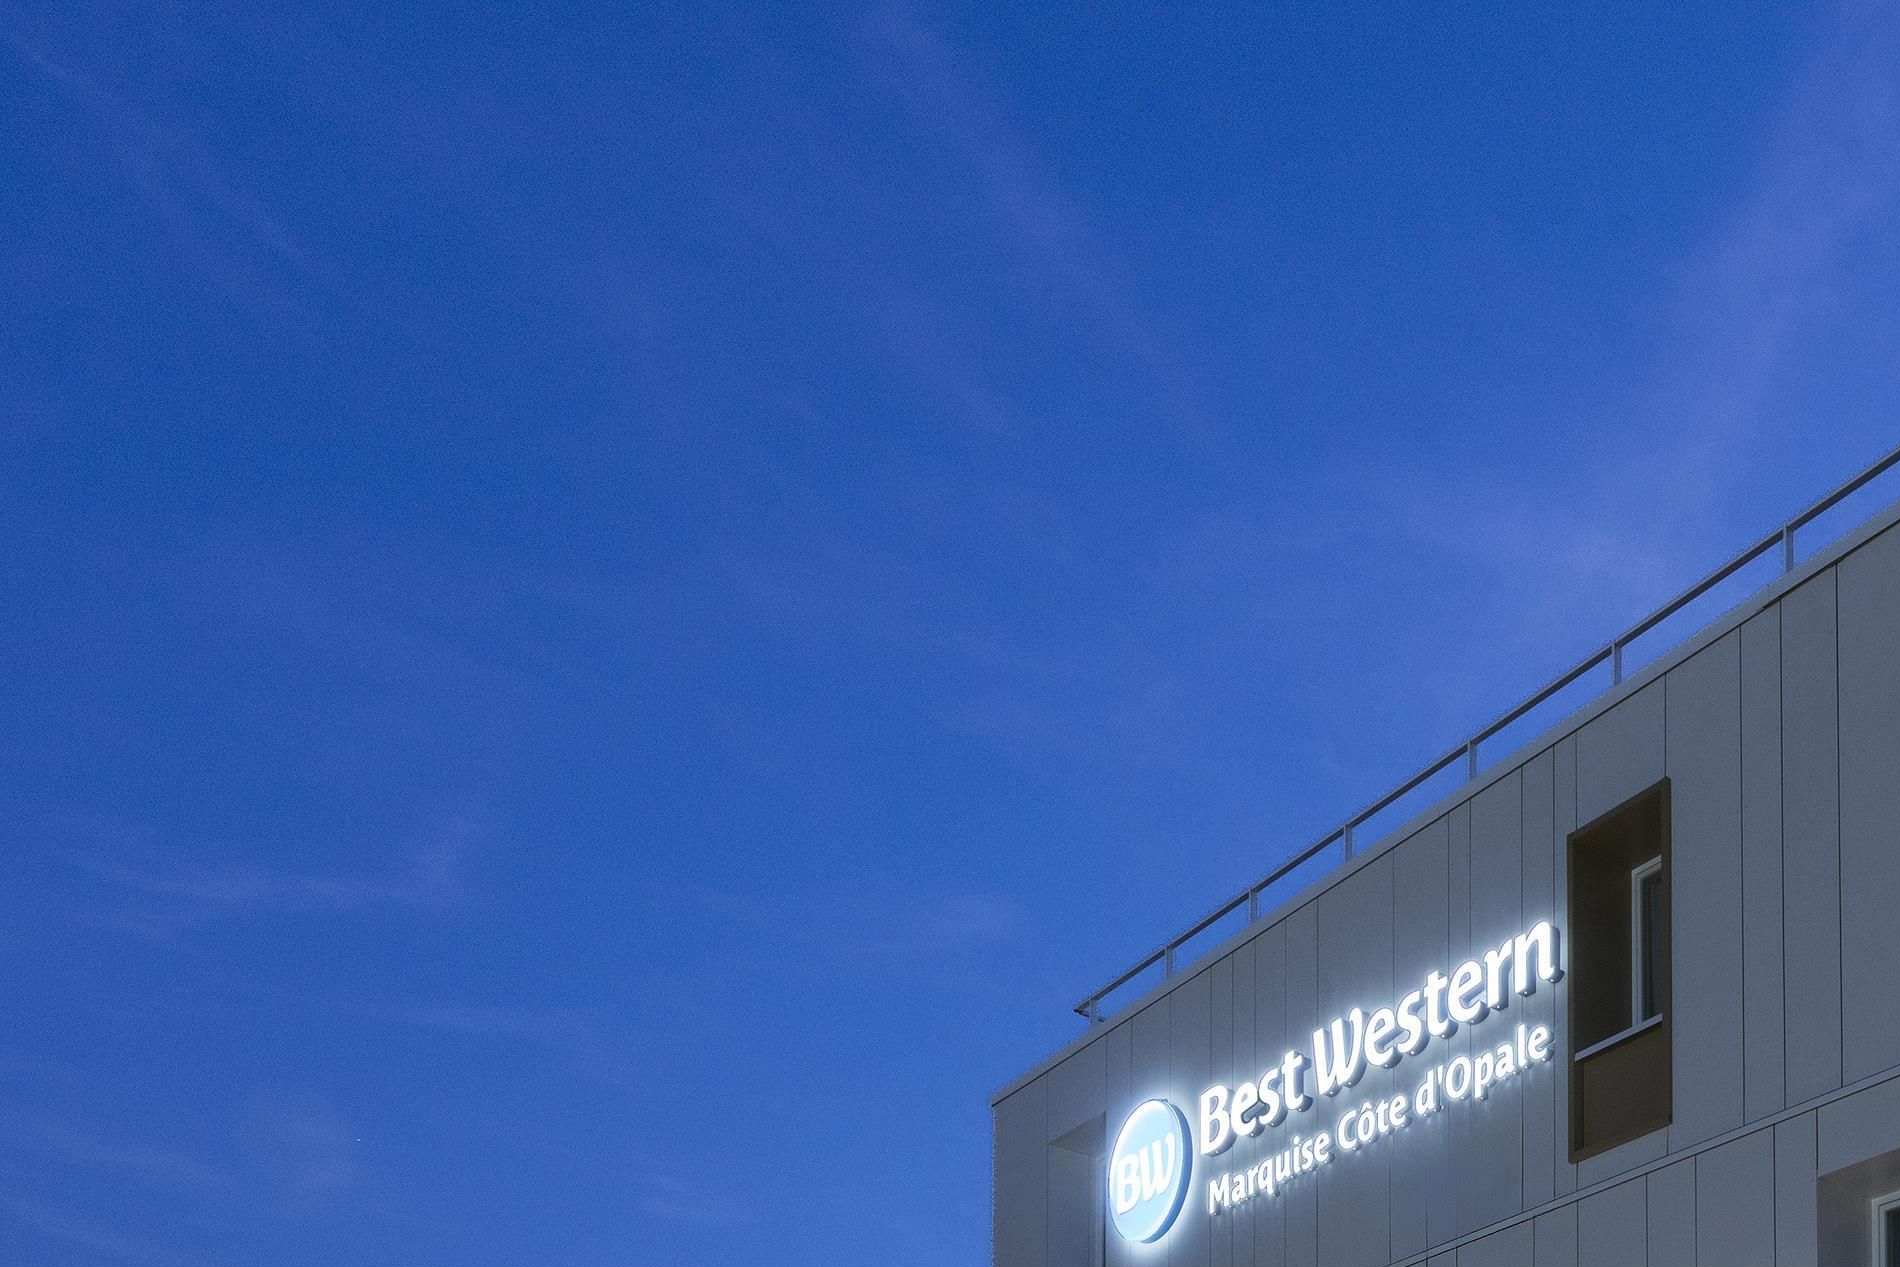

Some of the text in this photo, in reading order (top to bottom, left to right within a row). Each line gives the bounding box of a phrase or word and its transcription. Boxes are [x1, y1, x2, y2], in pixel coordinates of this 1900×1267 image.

[1200, 919, 1562, 1156] Best Western
[1208, 1023, 1551, 1214] Marquise Côte d'Opale
[1116, 1132, 1177, 1215] BW
